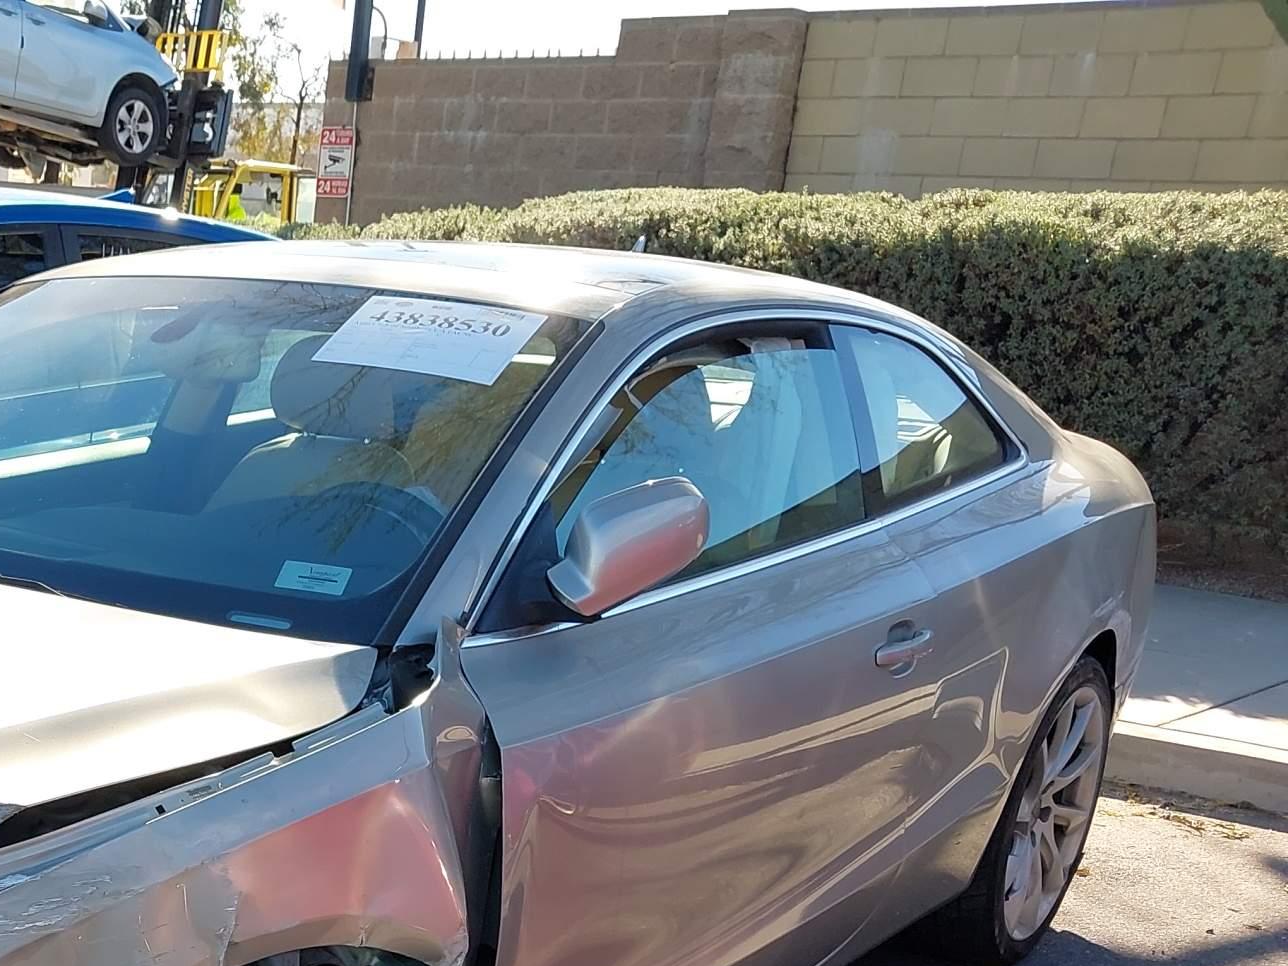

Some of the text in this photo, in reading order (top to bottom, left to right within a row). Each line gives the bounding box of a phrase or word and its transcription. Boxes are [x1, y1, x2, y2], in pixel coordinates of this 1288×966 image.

[322, 130, 336, 144] 24
[317, 180, 331, 193] 24
[369, 310, 512, 338] 43838530
